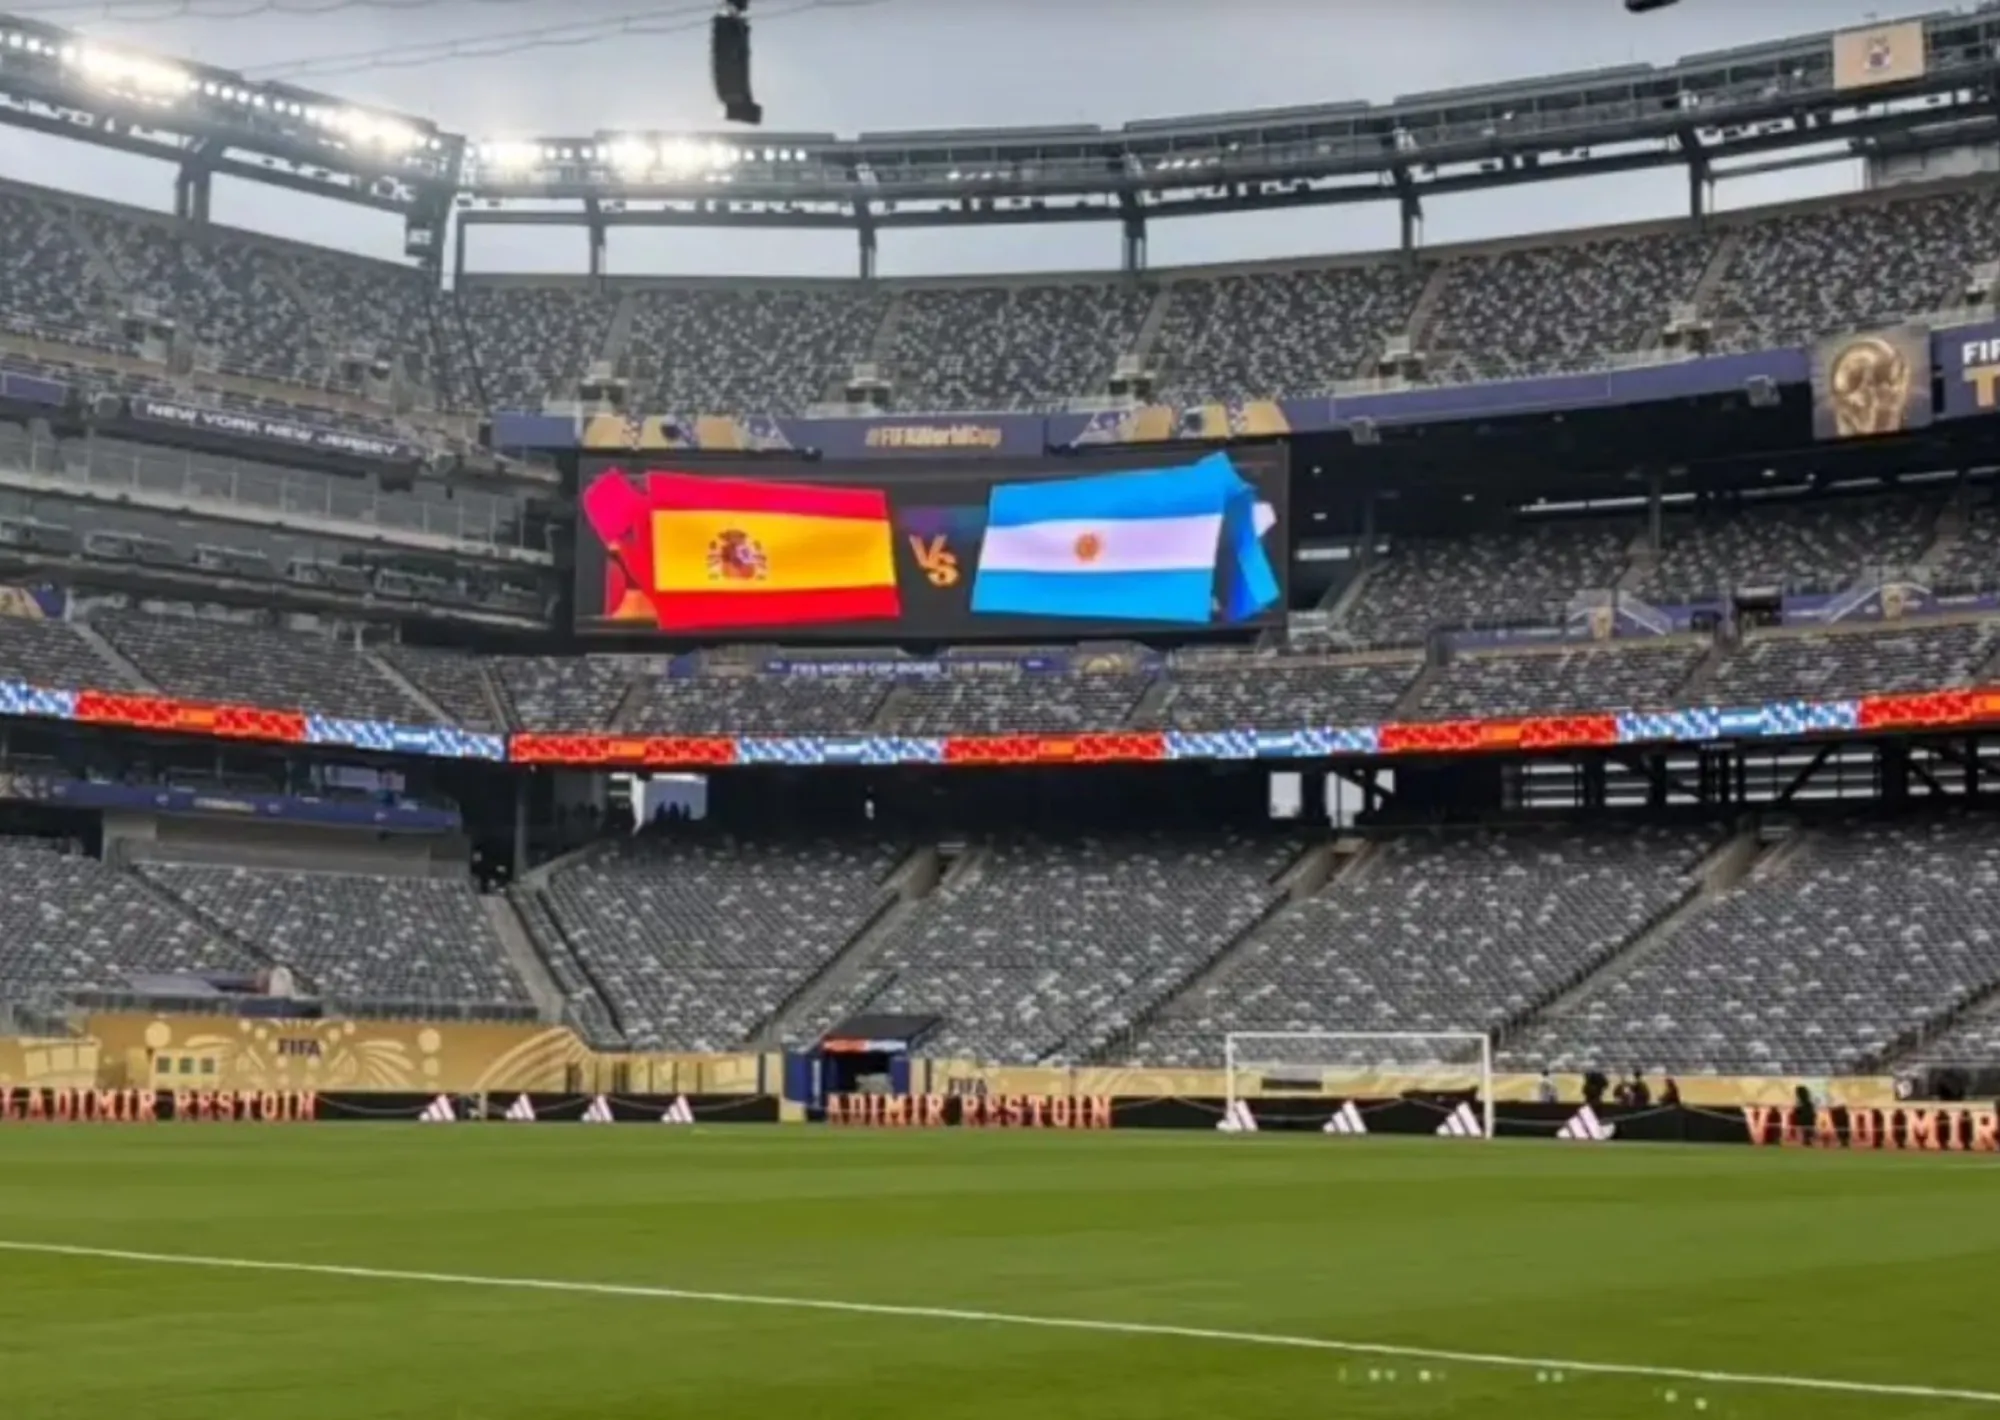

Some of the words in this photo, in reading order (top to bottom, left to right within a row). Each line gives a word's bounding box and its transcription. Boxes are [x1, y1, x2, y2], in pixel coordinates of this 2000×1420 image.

[146, 403, 197, 422] NEW
[202, 409, 260, 432] YORK
[264, 423, 313, 442] NEW
[316, 432, 397, 455] JERSEY
[909, 534, 959, 587] VS
[278, 1038, 321, 1055] FIFA
[949, 1077, 988, 1095] FIFA
[175, 1088, 317, 1122] RESTOIN
[961, 1095, 1111, 1129] RESTOIN
[1744, 1106, 1999, 1151] VLADIMIR
